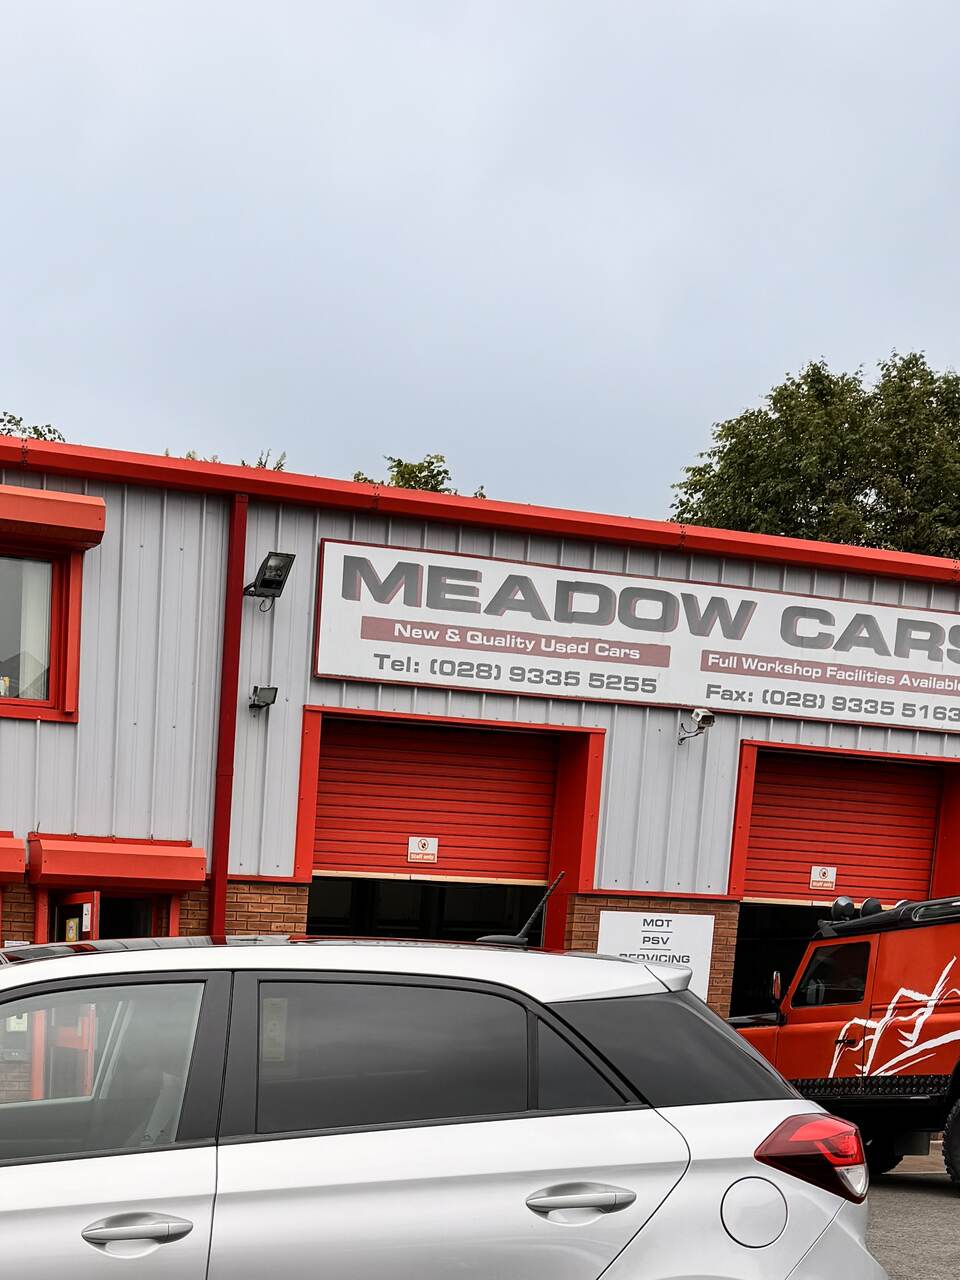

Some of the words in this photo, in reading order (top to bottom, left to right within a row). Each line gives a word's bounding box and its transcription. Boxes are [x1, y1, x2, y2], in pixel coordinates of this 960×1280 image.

[342, 555, 758, 640] MEADOW
[780, 605, 960, 664] CAR
[394, 623, 440, 640] New
[445, 629, 461, 642] &
[466, 631, 536, 652] Quality
[540, 638, 589, 654] Used
[595, 643, 641, 659] Cars
[373, 653, 420, 673] Tel:
[429, 658, 502, 681] (028)
[508, 665, 581, 688] 9335
[588, 672, 658, 694] 5255
[708, 654, 738, 669] Full
[741, 657, 822, 679] Workshop
[826, 666, 895, 685] Facilities
[705, 683, 754, 703] Fax:
[761, 689, 826, 709] (028)
[831, 695, 895, 716] 9335
[901, 702, 960, 722] 5163
[642, 918, 672, 928] MOT
[642, 936, 669, 945] PSV
